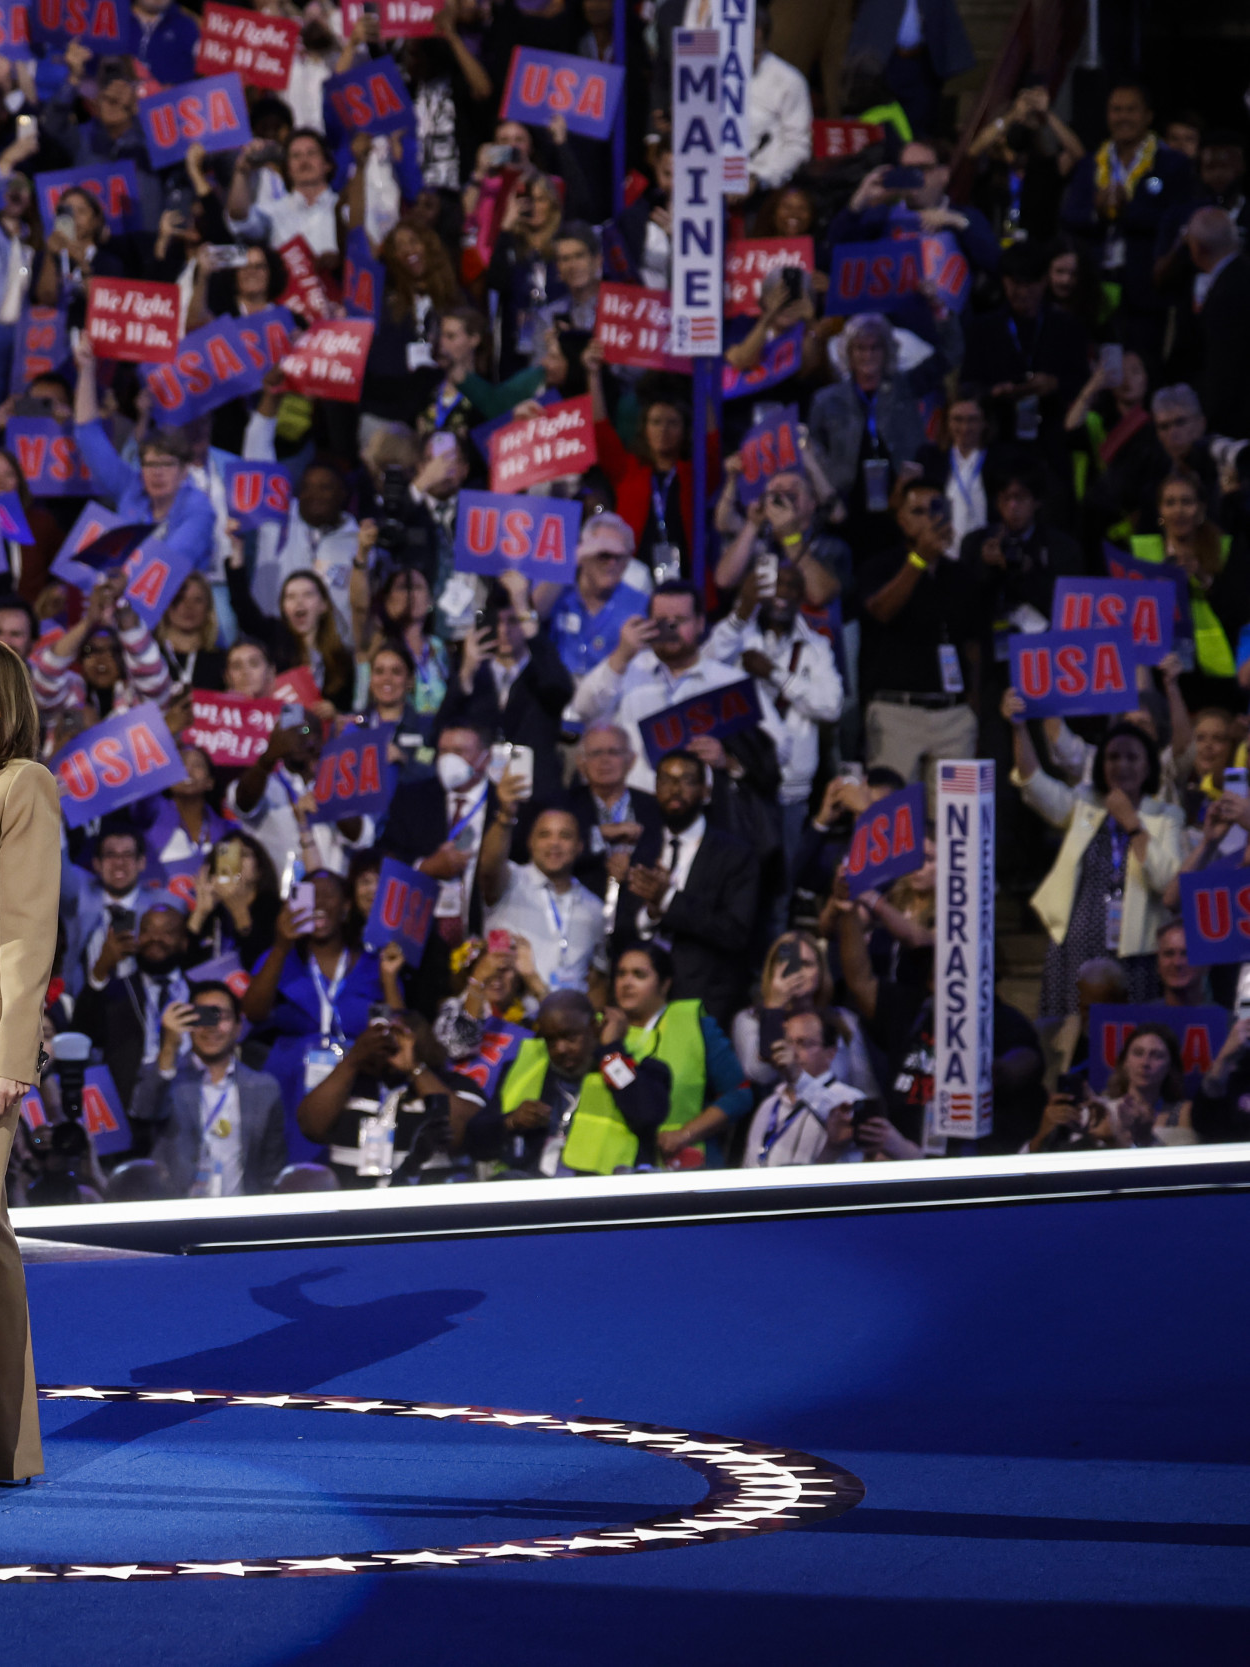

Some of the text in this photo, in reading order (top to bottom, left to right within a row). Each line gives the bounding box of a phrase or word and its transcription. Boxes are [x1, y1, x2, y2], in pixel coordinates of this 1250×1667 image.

[38, 0, 120, 39] USA
[150, 89, 240, 149] USA
[520, 63, 608, 120] USA
[679, 65, 716, 307] MAINE
[147, 333, 245, 410] USA
[740, 421, 794, 483] USA
[467, 506, 567, 563] USA
[1061, 593, 1161, 646] USA
[1019, 642, 1127, 700] USA
[650, 690, 752, 751] USA
[58, 722, 170, 802] USA
[314, 745, 381, 804] USA
[848, 805, 915, 875] USA
[944, 803, 969, 1086] NEBRASKA
[1100, 1022, 1214, 1076] UA
